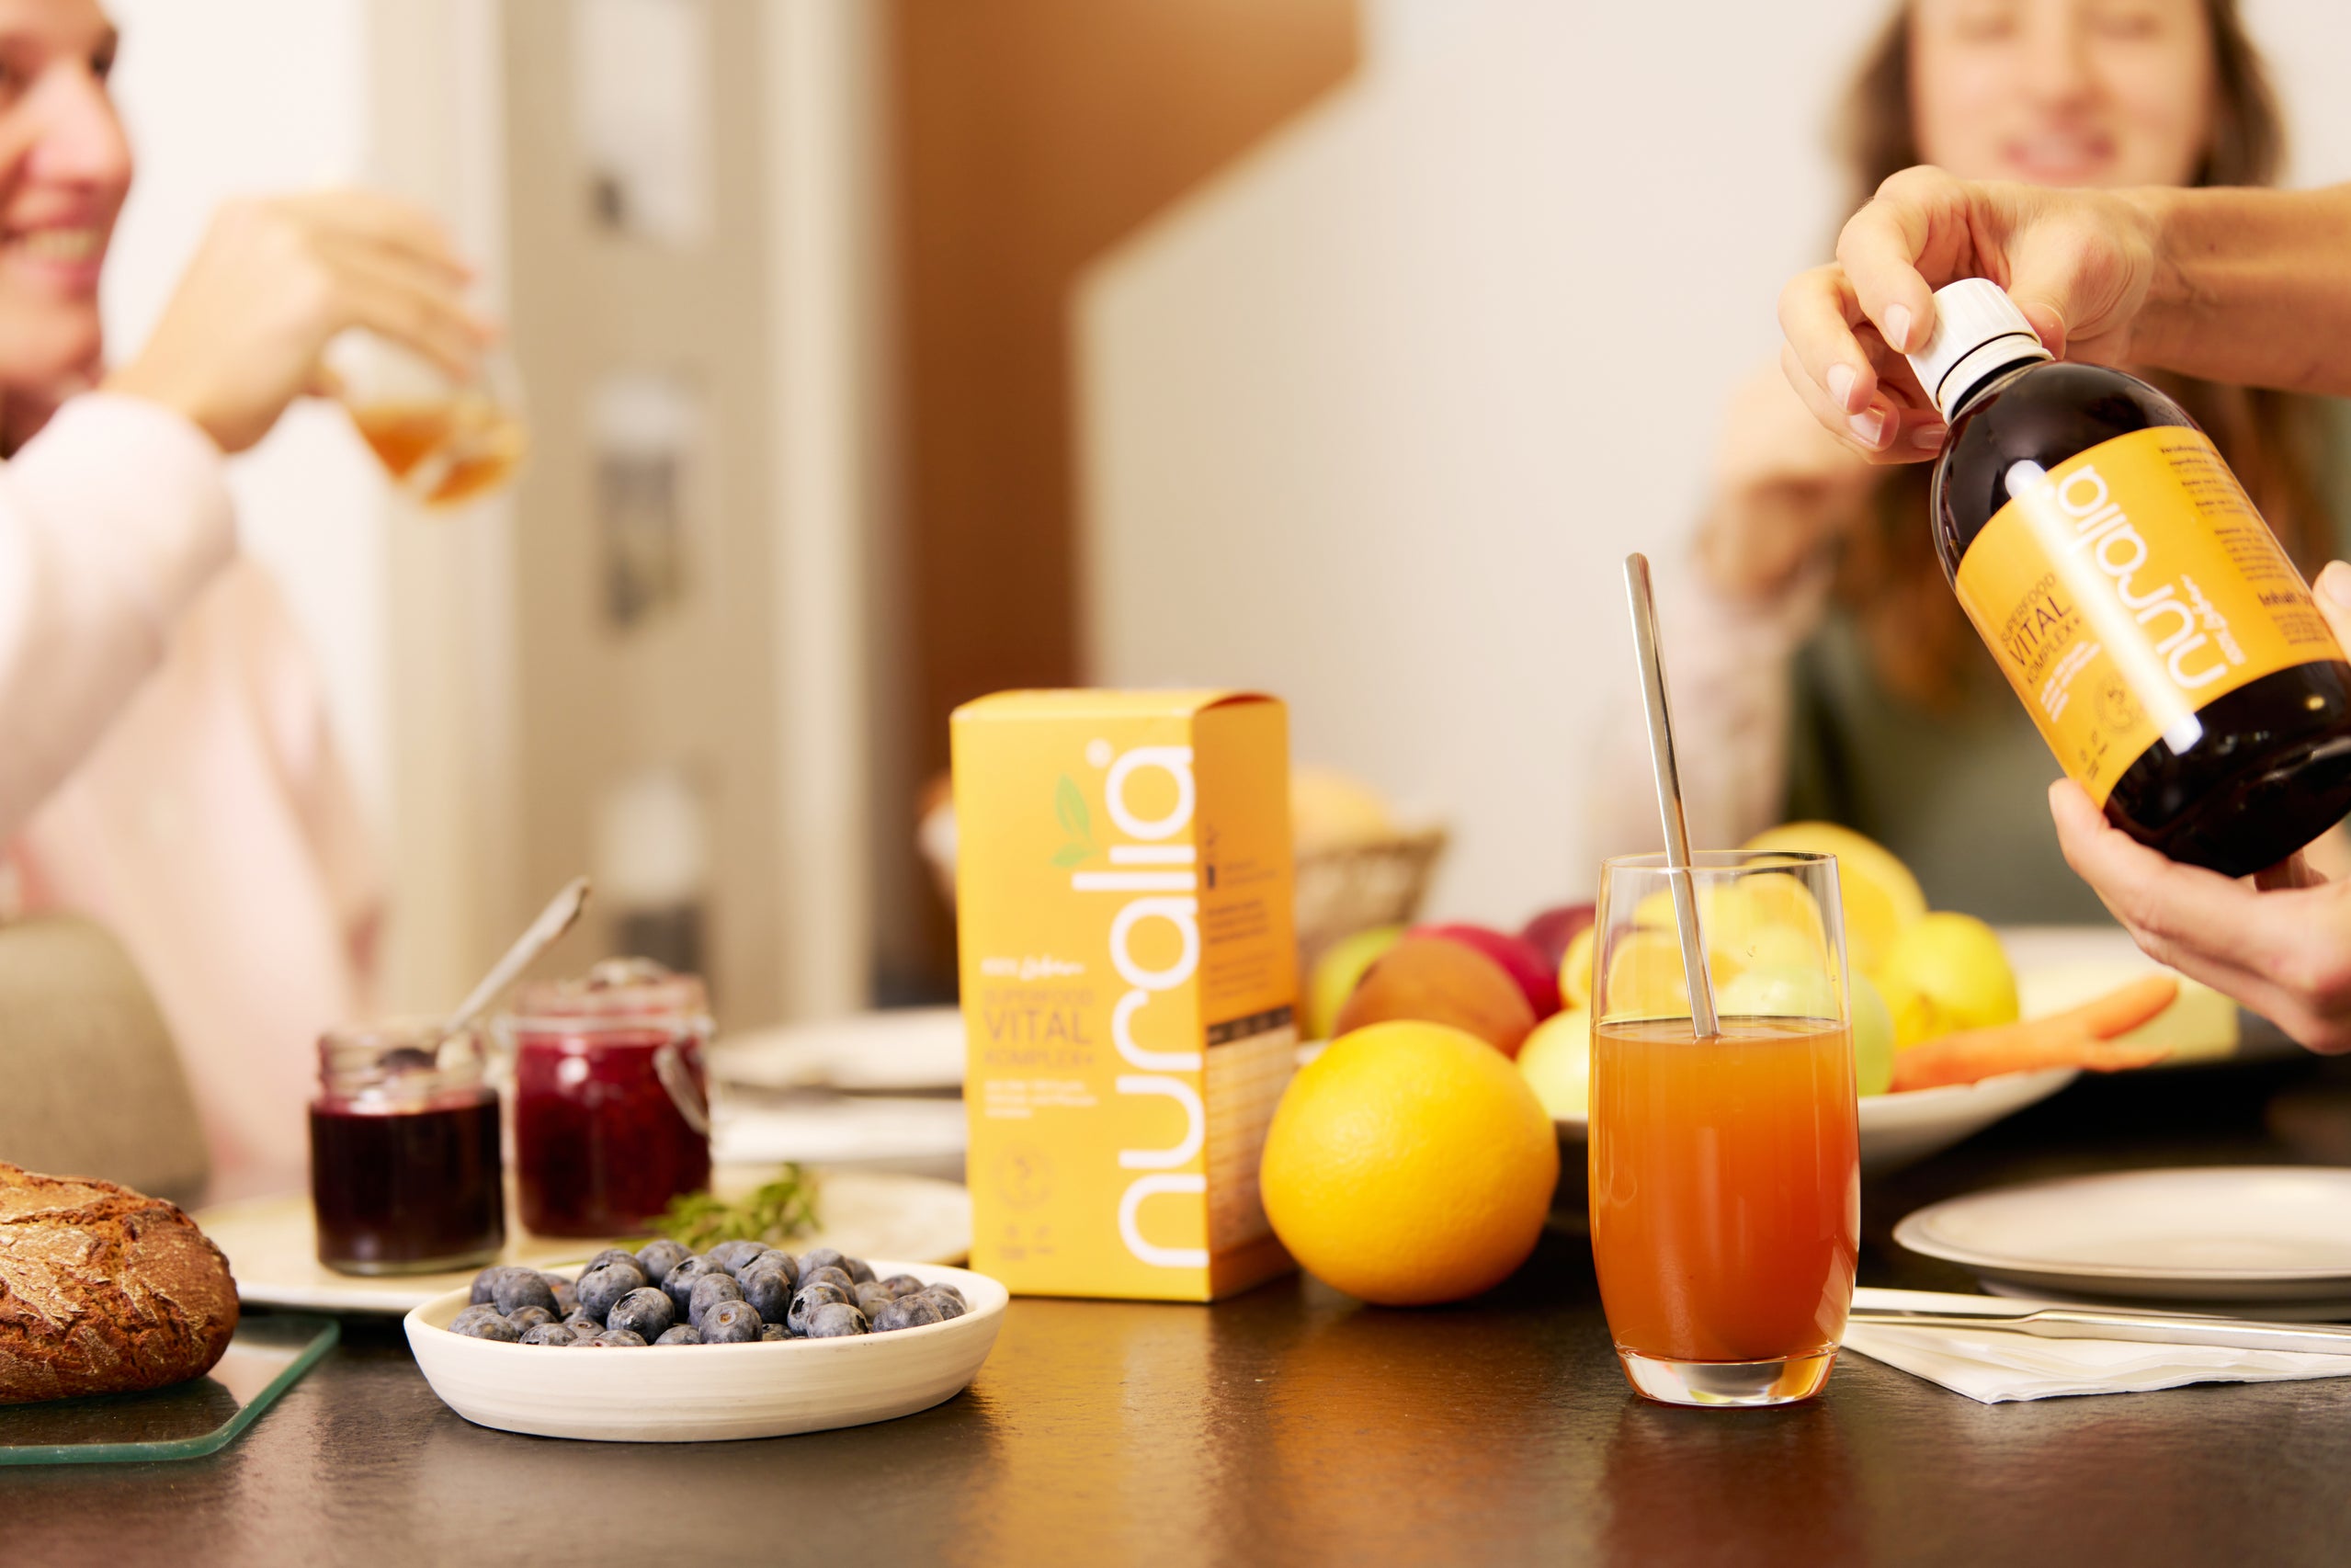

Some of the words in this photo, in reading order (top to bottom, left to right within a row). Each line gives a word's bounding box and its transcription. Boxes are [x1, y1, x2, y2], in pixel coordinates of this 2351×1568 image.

[2008, 596, 2072, 666] VITAL
[2057, 464, 2229, 690] nuralia
[982, 1007, 1095, 1045] VITAL
[1071, 745, 1211, 1269] nuralia
